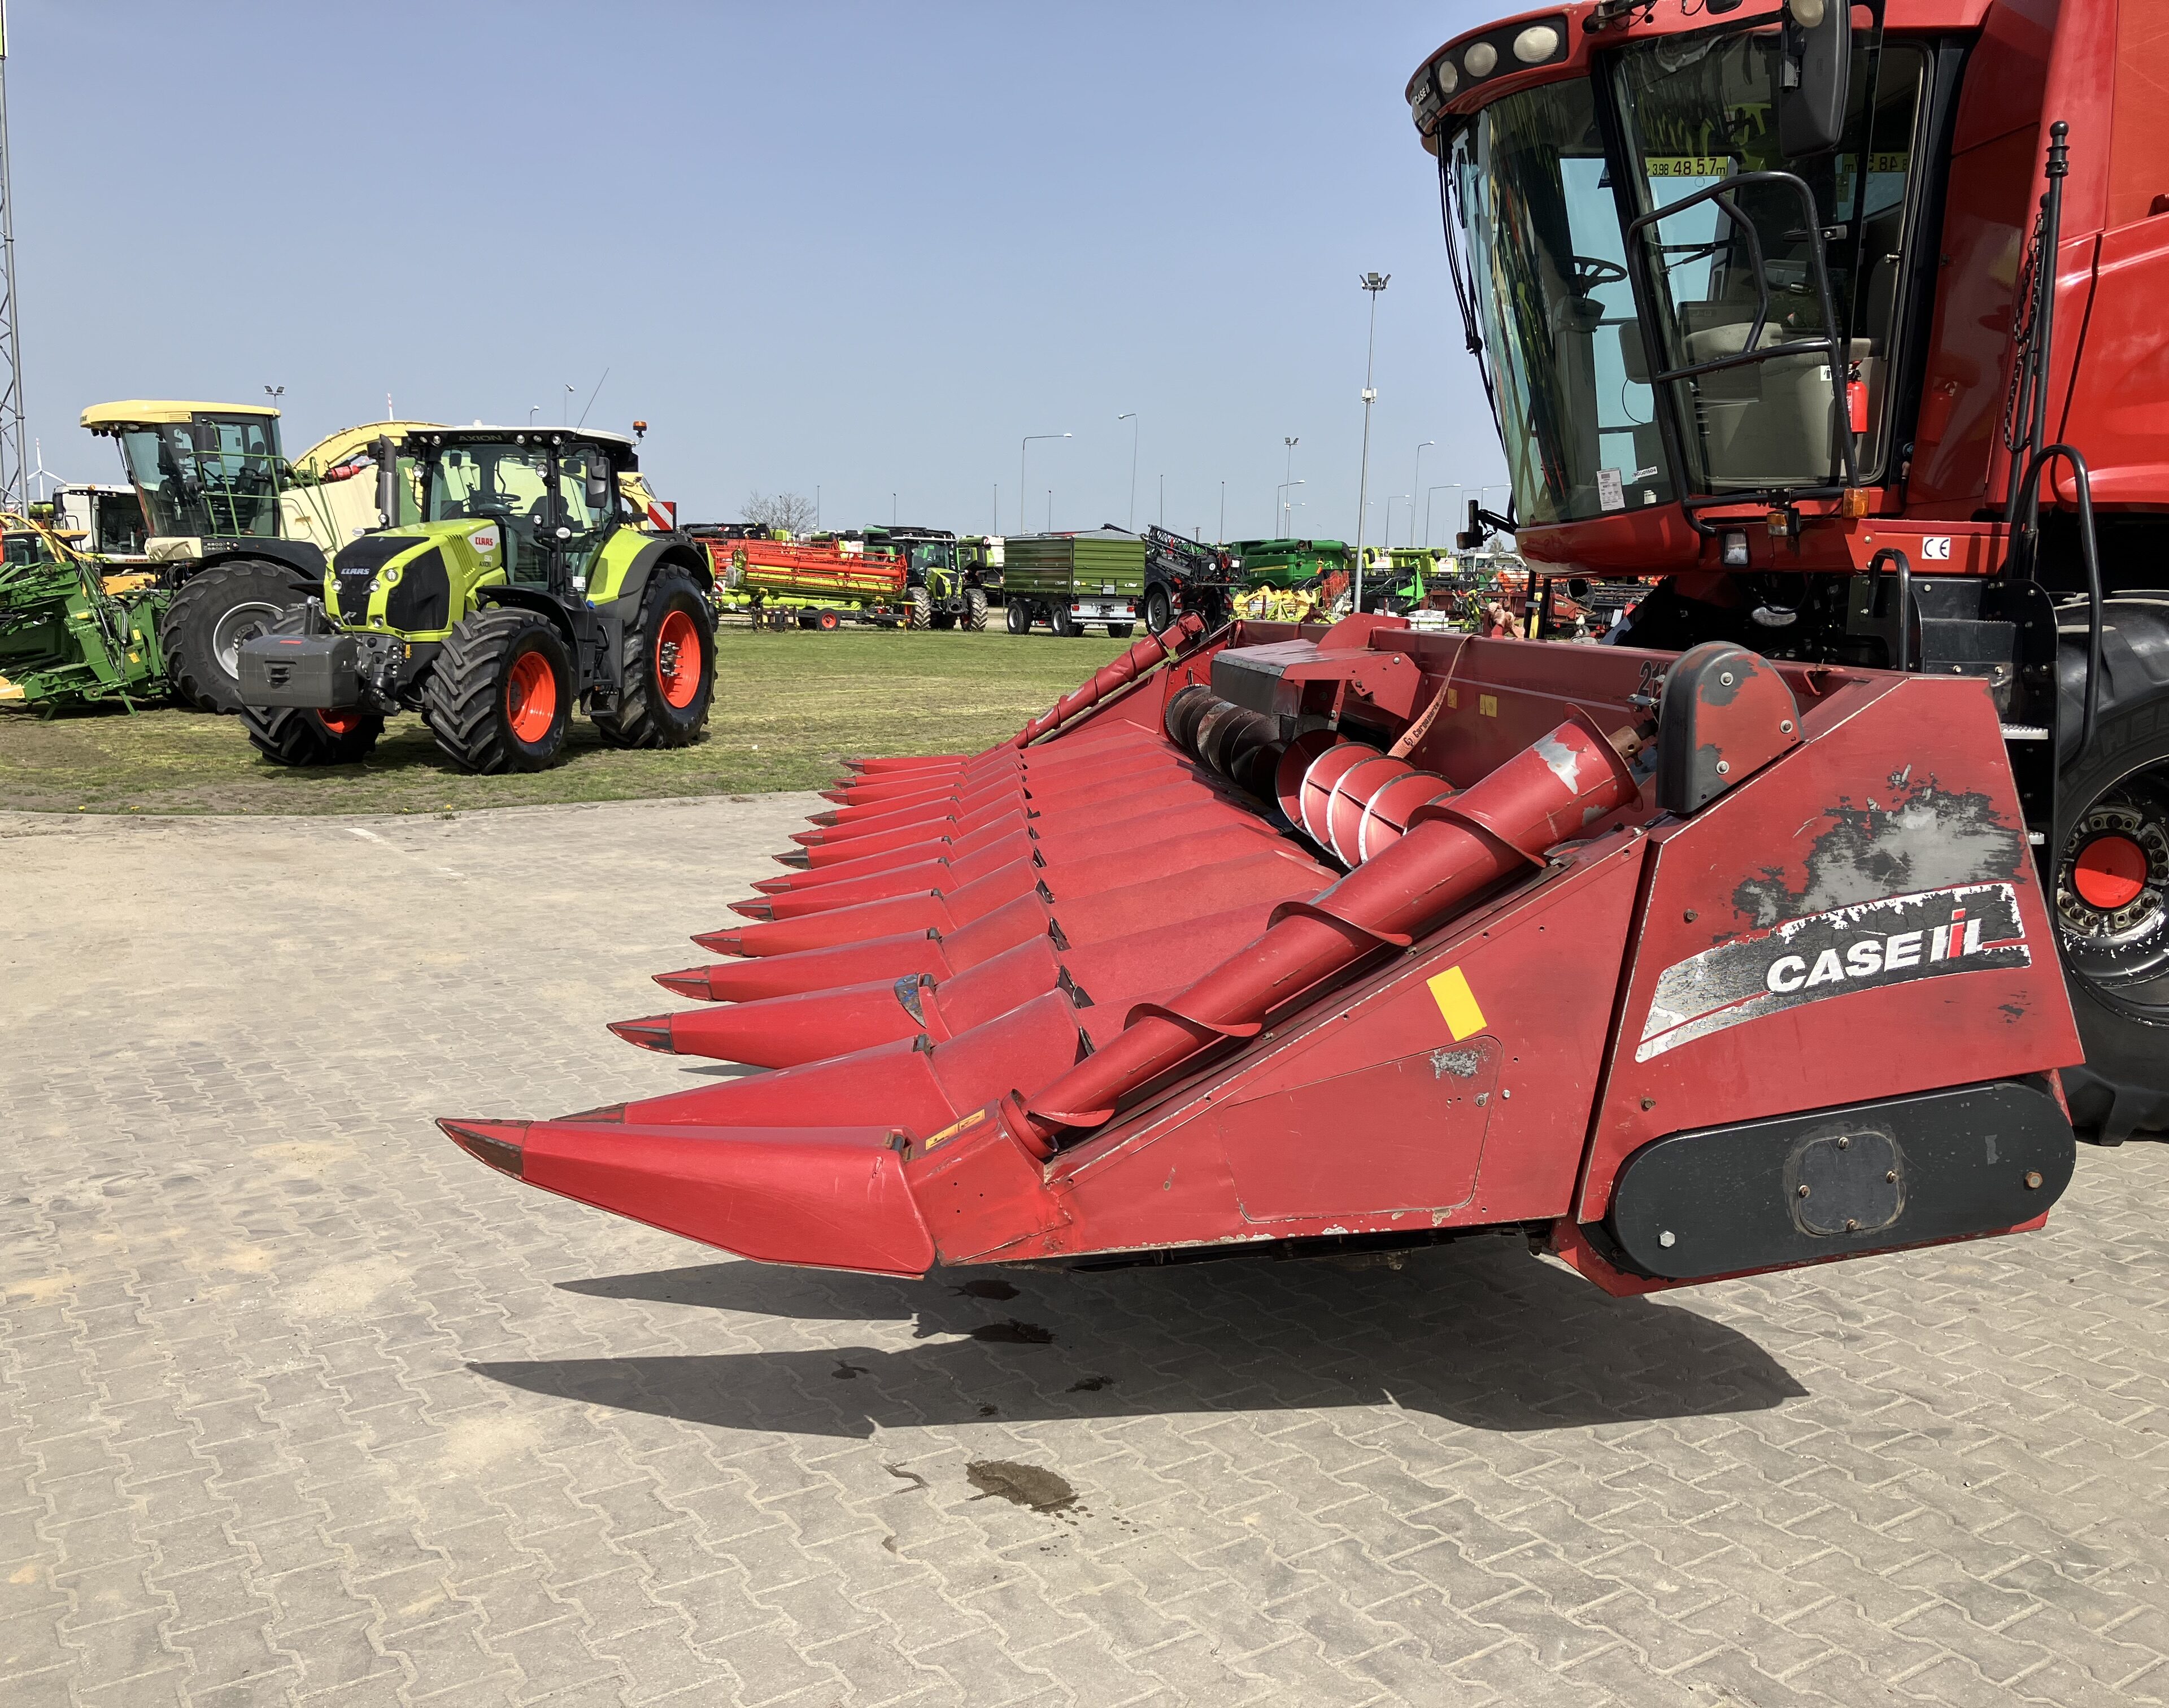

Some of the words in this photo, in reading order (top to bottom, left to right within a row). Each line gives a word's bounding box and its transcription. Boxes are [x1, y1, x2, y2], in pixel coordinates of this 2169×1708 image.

[1414, 87, 1427, 105] CASE
[1653, 163, 1669, 176] 3.98
[1674, 160, 1692, 176] 4.8
[475, 537, 493, 546] CLAAS
[1767, 930, 1923, 993] CASE
